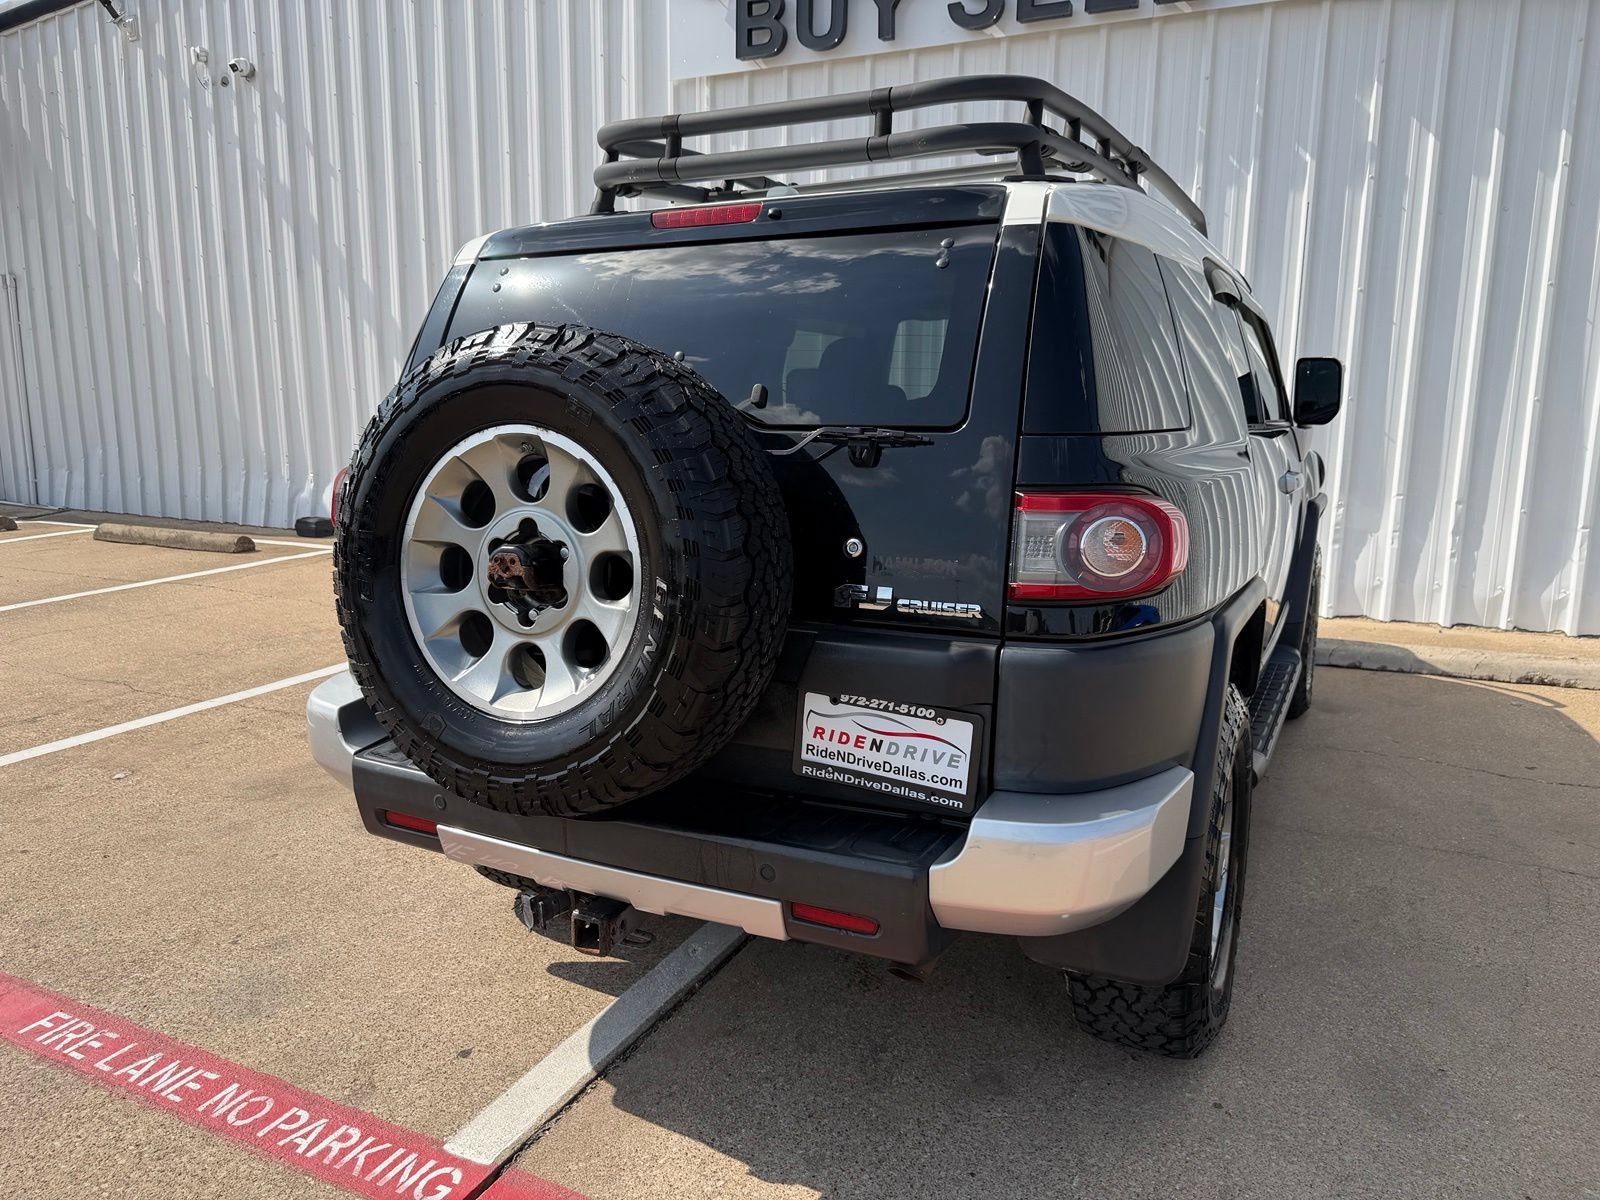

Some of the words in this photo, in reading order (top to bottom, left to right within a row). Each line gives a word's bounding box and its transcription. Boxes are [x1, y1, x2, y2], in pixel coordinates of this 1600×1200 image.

[834, 584, 893, 610] FJ
[896, 599, 983, 619] CRUISER
[578, 576, 668, 740] GENERAL
[840, 694, 935, 719] 972-271-5100
[802, 766, 963, 809] RideNDriveDallas.com
[805, 744, 962, 789] RideNDriveDallas.com
[17, 1010, 119, 1058] FIRE
[94, 1043, 219, 1101] LANE
[197, 1083, 273, 1127] NO
[268, 1106, 463, 1200] PARKING
